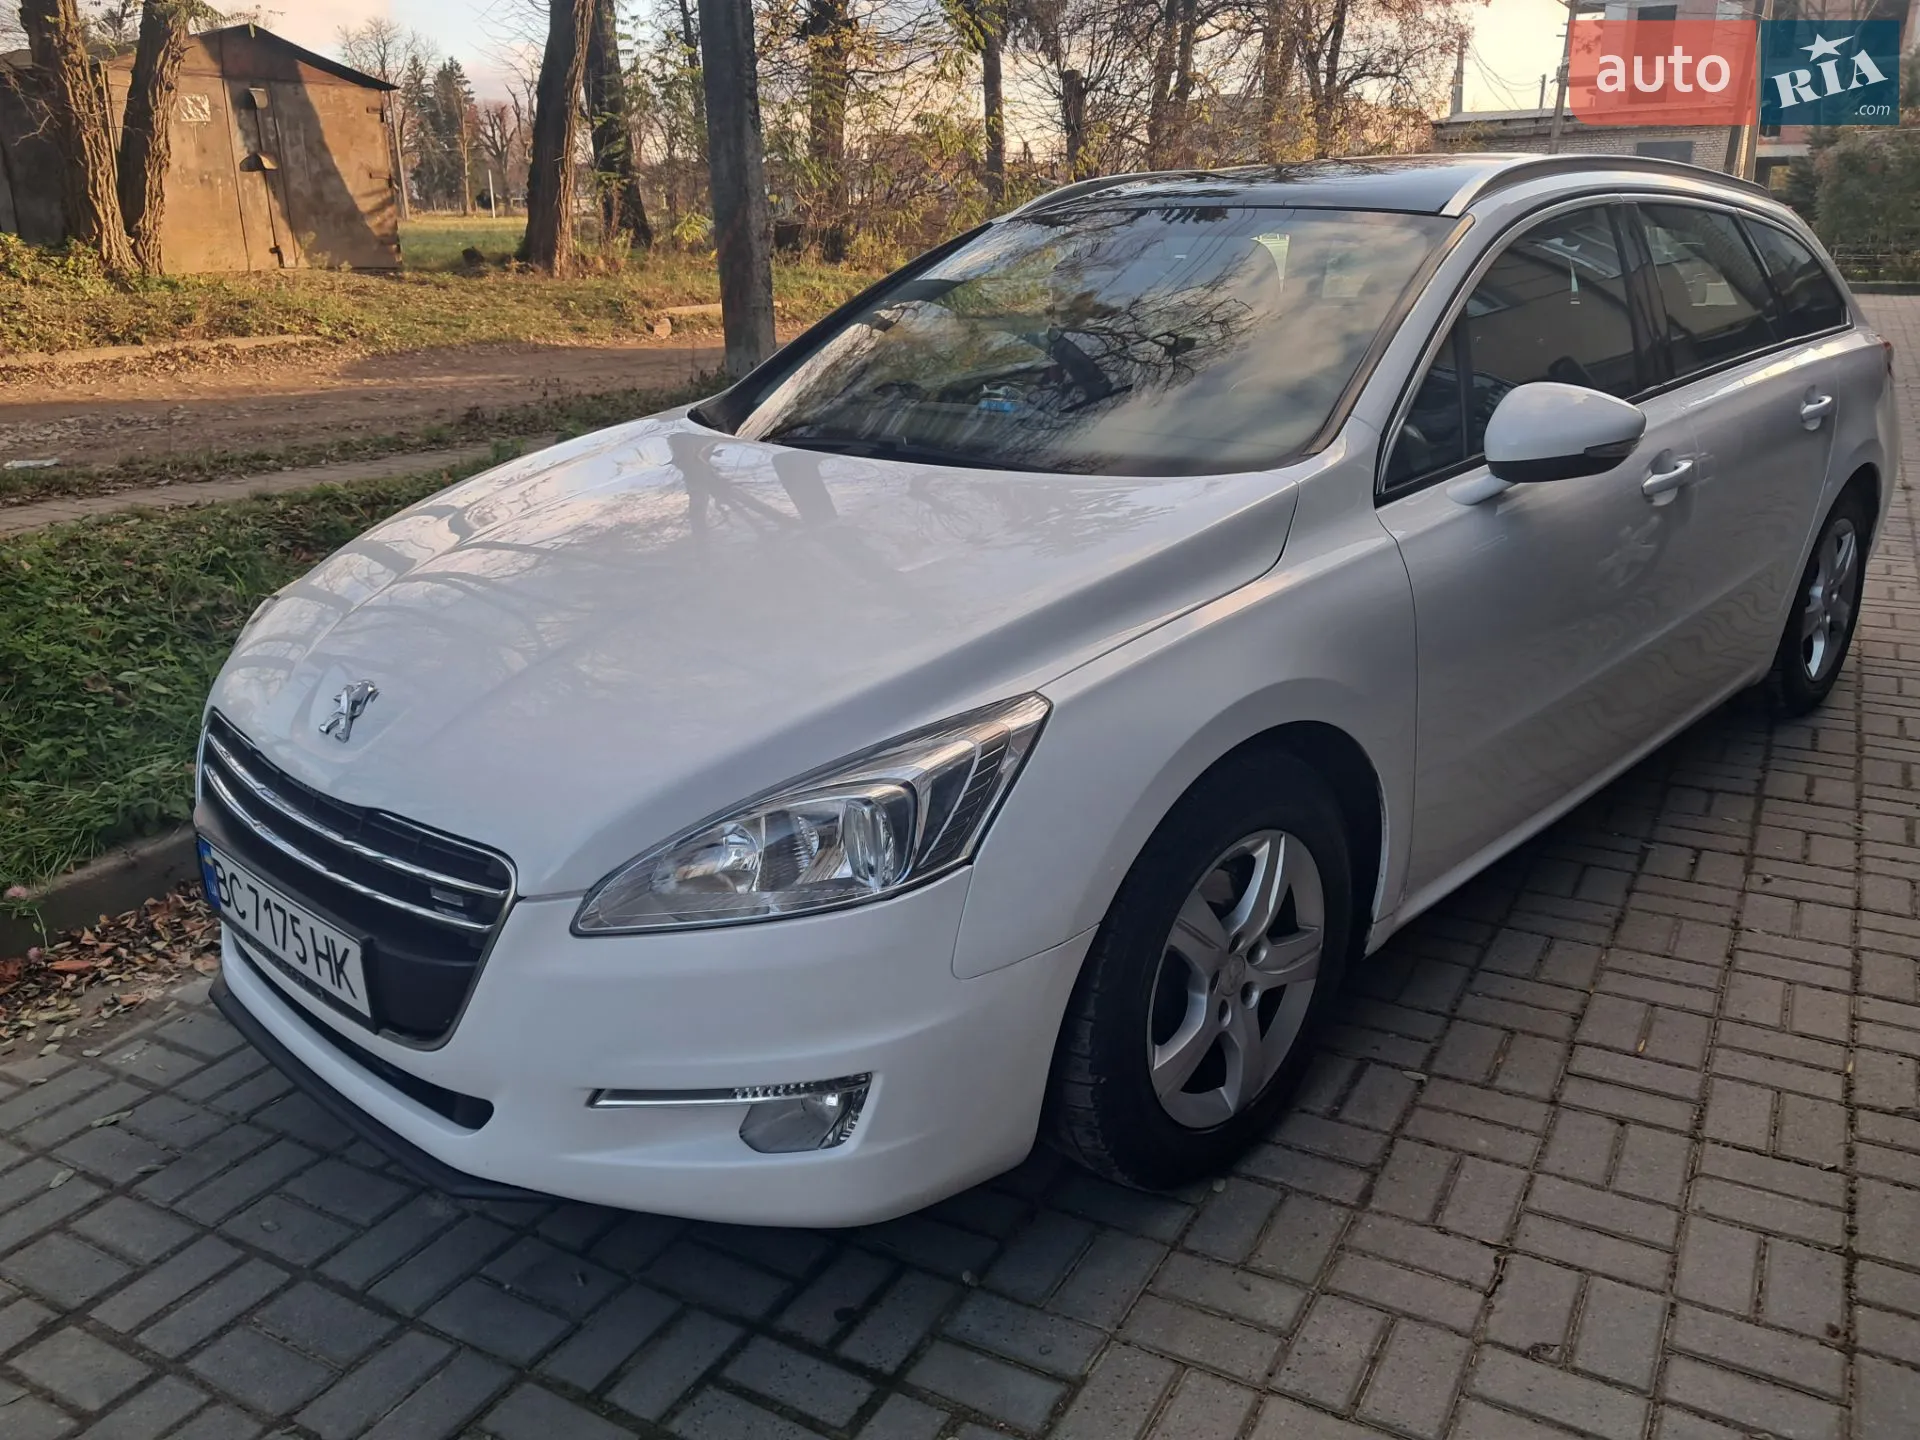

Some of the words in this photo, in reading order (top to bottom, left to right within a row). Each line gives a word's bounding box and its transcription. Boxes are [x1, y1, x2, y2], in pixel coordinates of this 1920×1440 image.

[214, 858, 247, 920] BC
[247, 884, 307, 965] 7175
[310, 926, 357, 1000] HK
